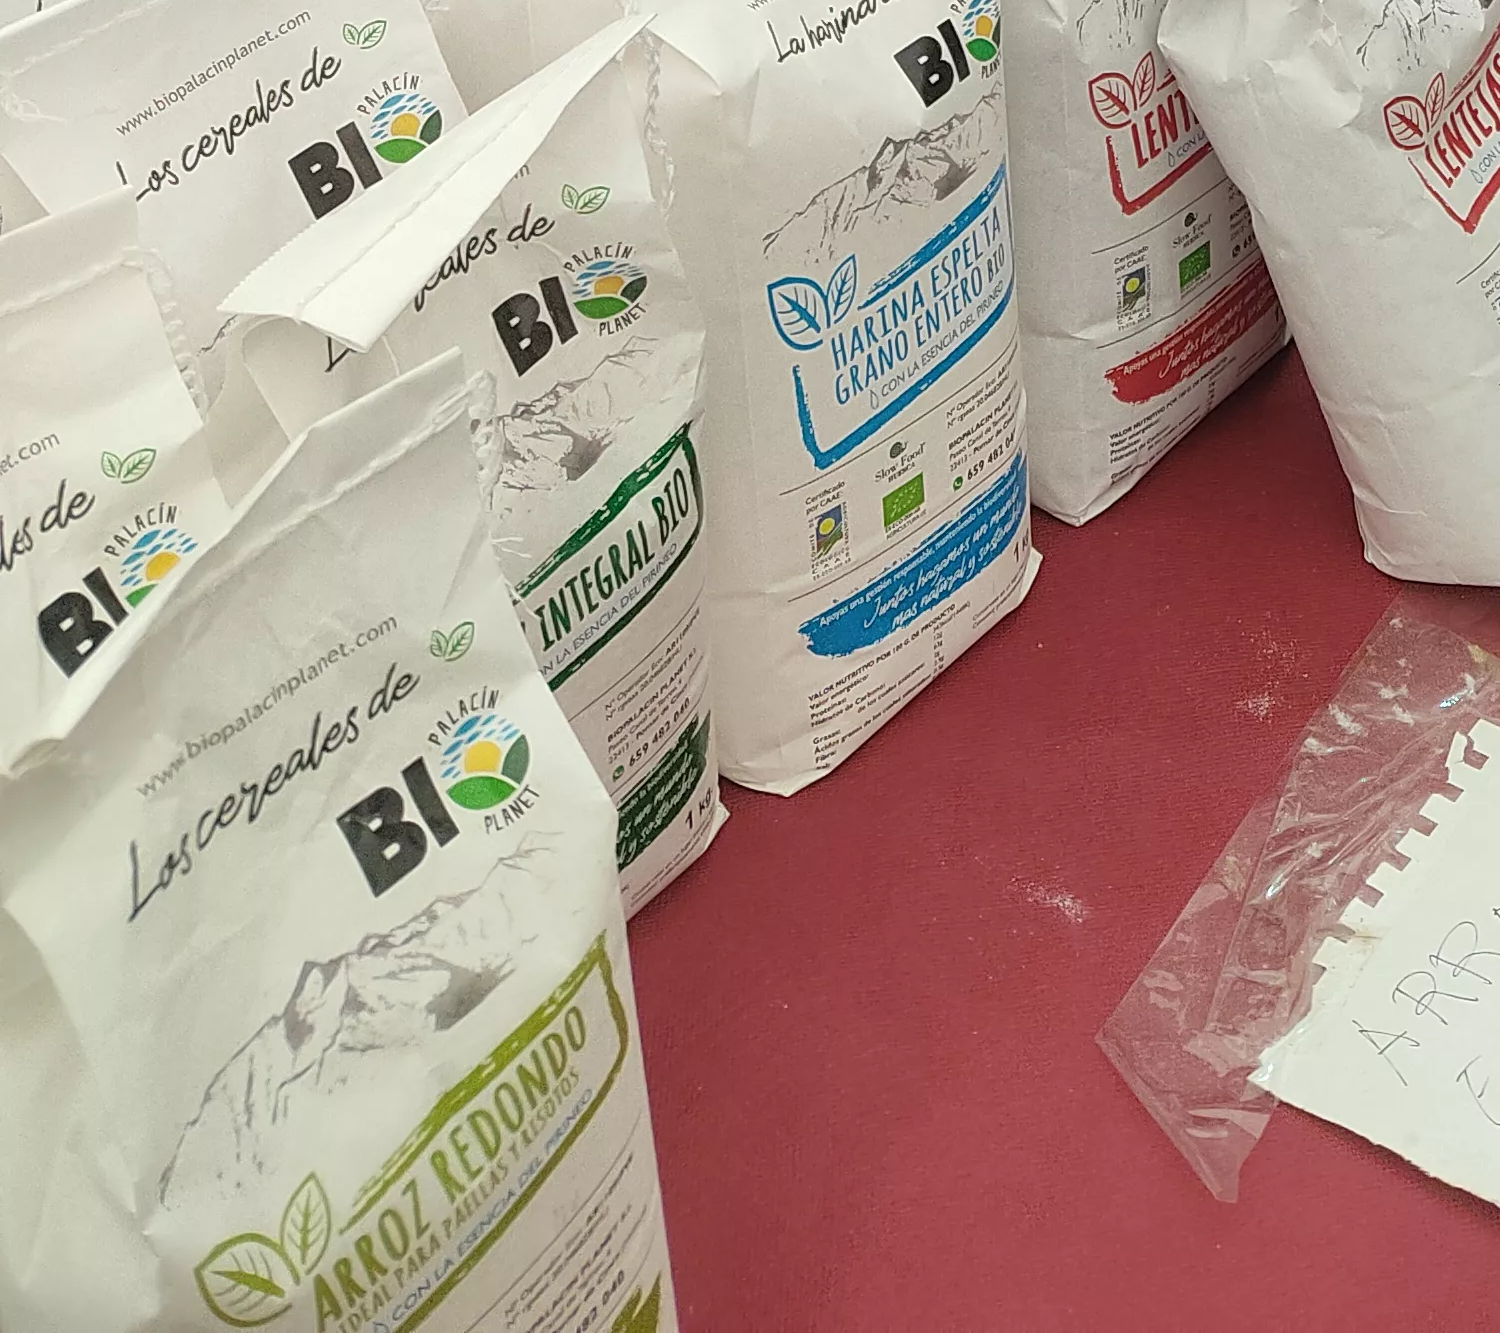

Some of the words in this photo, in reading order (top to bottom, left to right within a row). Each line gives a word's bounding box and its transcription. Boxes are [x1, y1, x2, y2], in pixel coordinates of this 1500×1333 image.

[766, 19, 806, 63] La
[115, 10, 312, 136] www.biopalacinplanet.com
[356, 71, 422, 116] PALACÍN
[180, 78, 295, 174] cereales
[300, 45, 342, 92] de
[1478, 154, 1496, 174] CON
[505, 202, 556, 243] de
[563, 240, 635, 273] PALACÍN
[830, 279, 925, 371] HARINA
[930, 205, 1001, 299] ESPELTA
[598, 301, 647, 337] PLANET
[834, 337, 909, 406] GRANO
[916, 270, 983, 349] ENTERO
[987, 242, 1006, 284] BIO
[881, 372, 907, 399] CON
[907, 360, 921, 379] LA
[920, 328, 959, 367] ESENCIA
[958, 314, 976, 334] DEL
[976, 279, 1004, 318] PIRINEO
[39, 478, 96, 532] de
[104, 501, 179, 558] PALACÍN
[540, 526, 655, 652] INTEGRAL
[653, 467, 691, 547] BIO
[572, 604, 619, 654] ESENCIA
[618, 586, 642, 617] DEL
[641, 541, 679, 594] PIRINEO
[427, 685, 500, 747] PALACÍN
[627, 745, 651, 769] 659
[127, 839, 191, 923] Los
[195, 704, 359, 852] cereales
[368, 661, 421, 723] de
[483, 785, 541, 835] PLANET
[312, 1178, 431, 1333] ARROZ
[429, 1004, 587, 1207] REDONDO
[393, 1233, 442, 1289] PARA
[390, 1278, 432, 1324] CON
